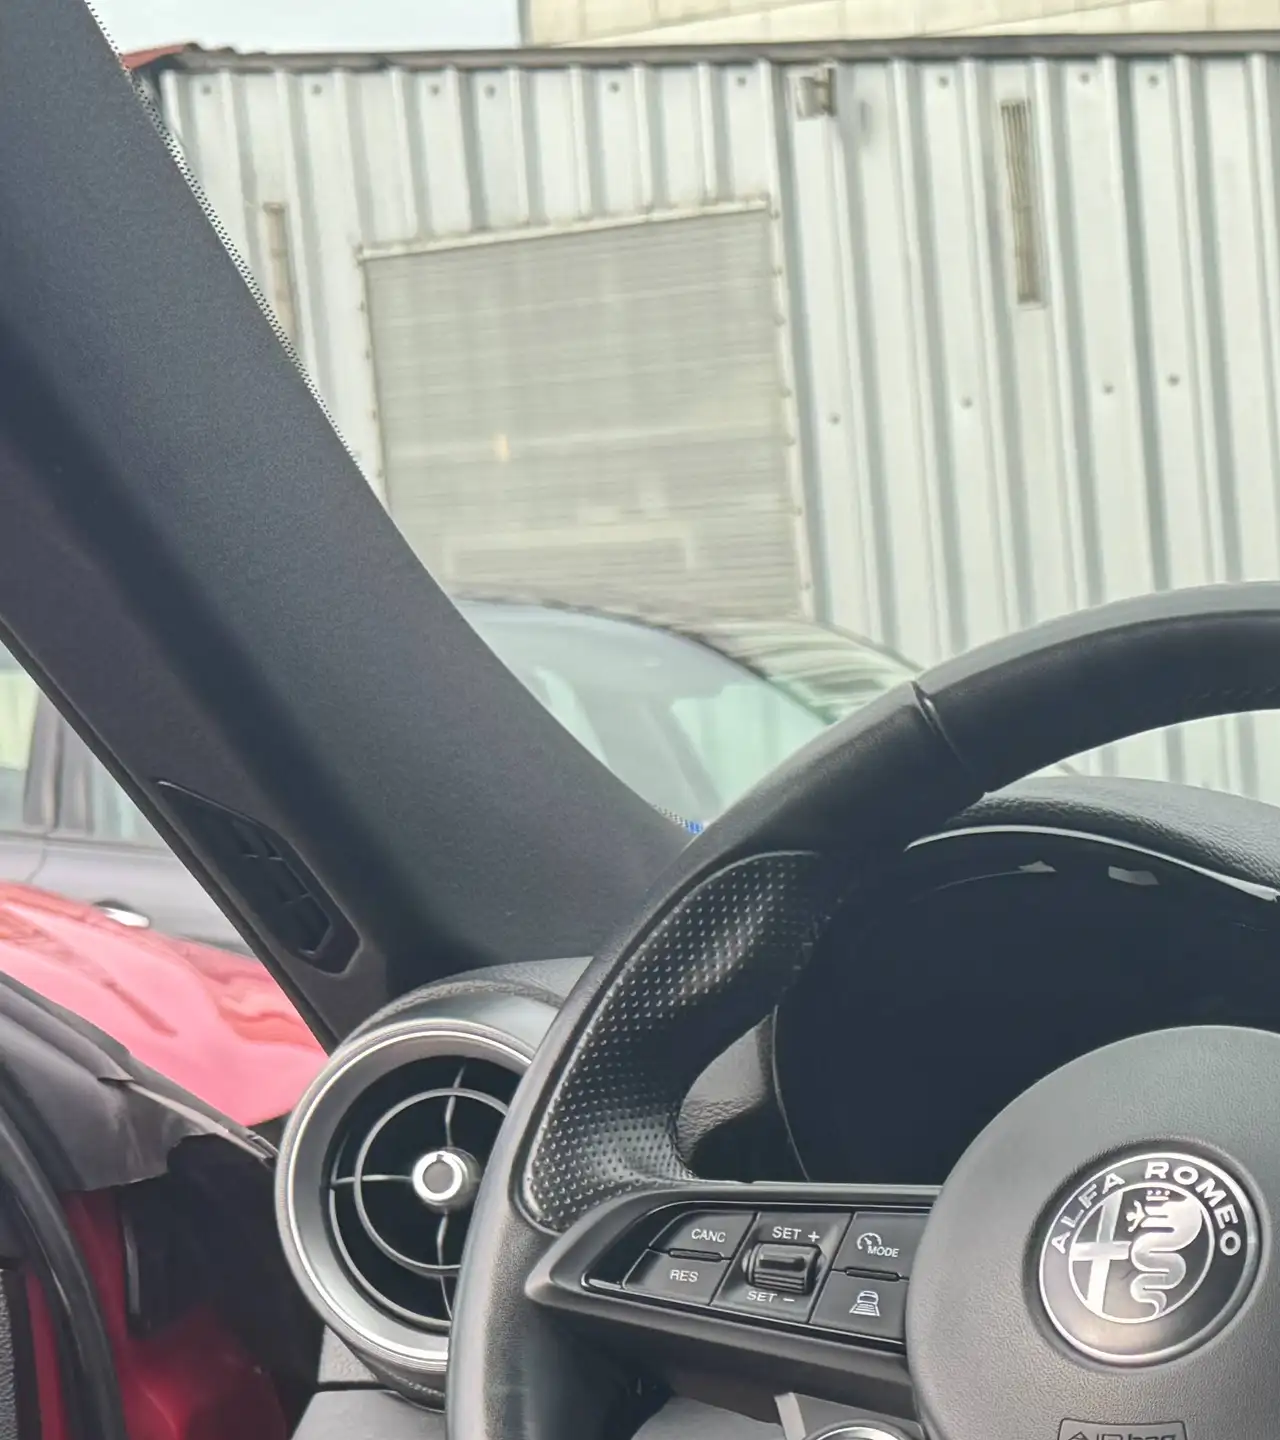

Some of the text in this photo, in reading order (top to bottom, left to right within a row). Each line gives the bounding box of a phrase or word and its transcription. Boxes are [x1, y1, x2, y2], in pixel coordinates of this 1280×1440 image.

[1051, 1161, 1242, 1257] ALFA ROMEO
[691, 1228, 726, 1244] CANC
[772, 1226, 801, 1241] SET
[867, 1247, 899, 1259] MODE
[670, 1269, 698, 1283] RES
[746, 1290, 777, 1303] SET
